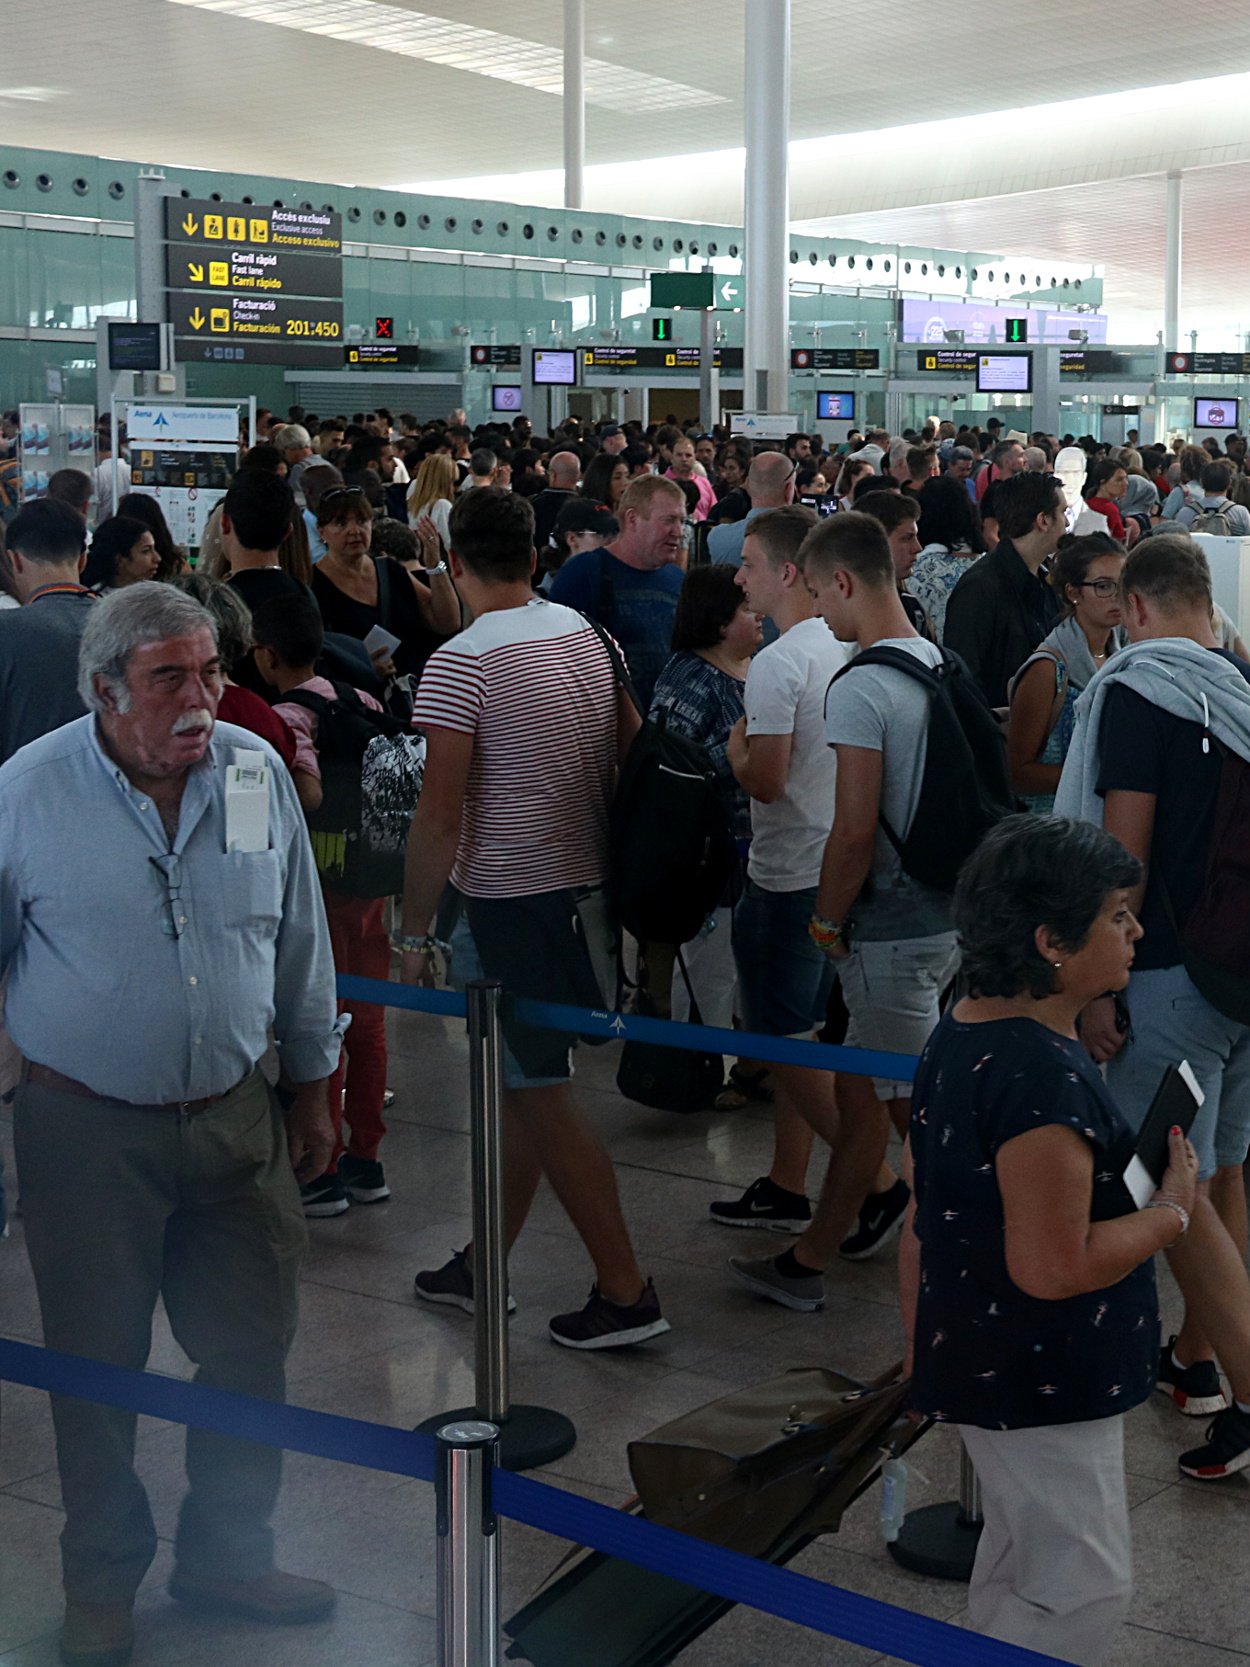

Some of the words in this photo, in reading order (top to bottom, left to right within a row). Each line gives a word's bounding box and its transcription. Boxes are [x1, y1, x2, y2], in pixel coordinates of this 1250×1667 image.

[272, 233, 301, 245] Acceso
[302, 236, 340, 248] exclusivo
[232, 252, 255, 265] Carril
[232, 264, 248, 274] Fast
[248, 266, 263, 276] lane
[232, 276, 255, 287] Carril
